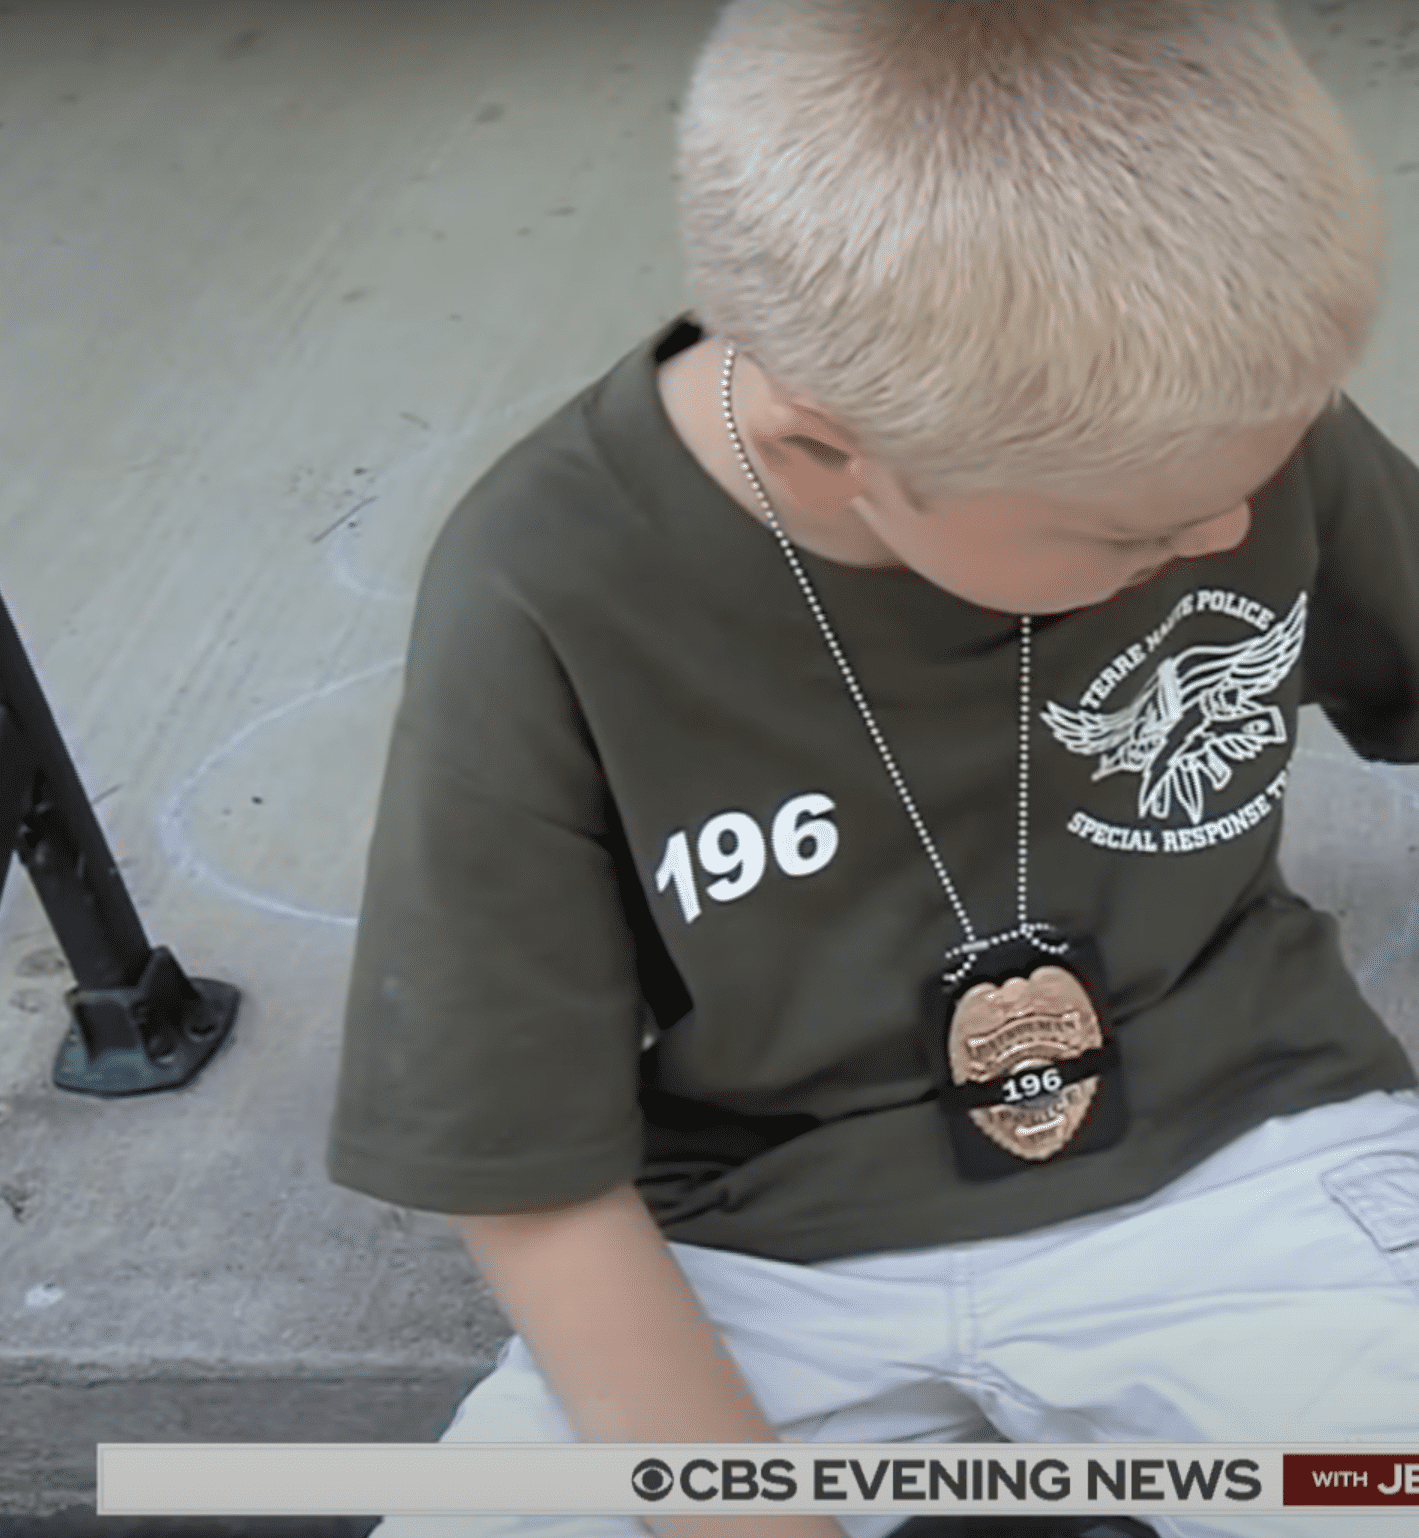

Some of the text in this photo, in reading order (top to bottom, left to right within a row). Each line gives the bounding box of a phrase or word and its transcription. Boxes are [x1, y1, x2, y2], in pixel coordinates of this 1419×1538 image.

[1080, 643, 1147, 709] TERRE
[1196, 589, 1276, 631] POLICE
[655, 792, 840, 925] 196
[1067, 811, 1158, 852] SPECIAL
[1162, 794, 1272, 852] RESPONSE
[1001, 1068, 1063, 1102] 196
